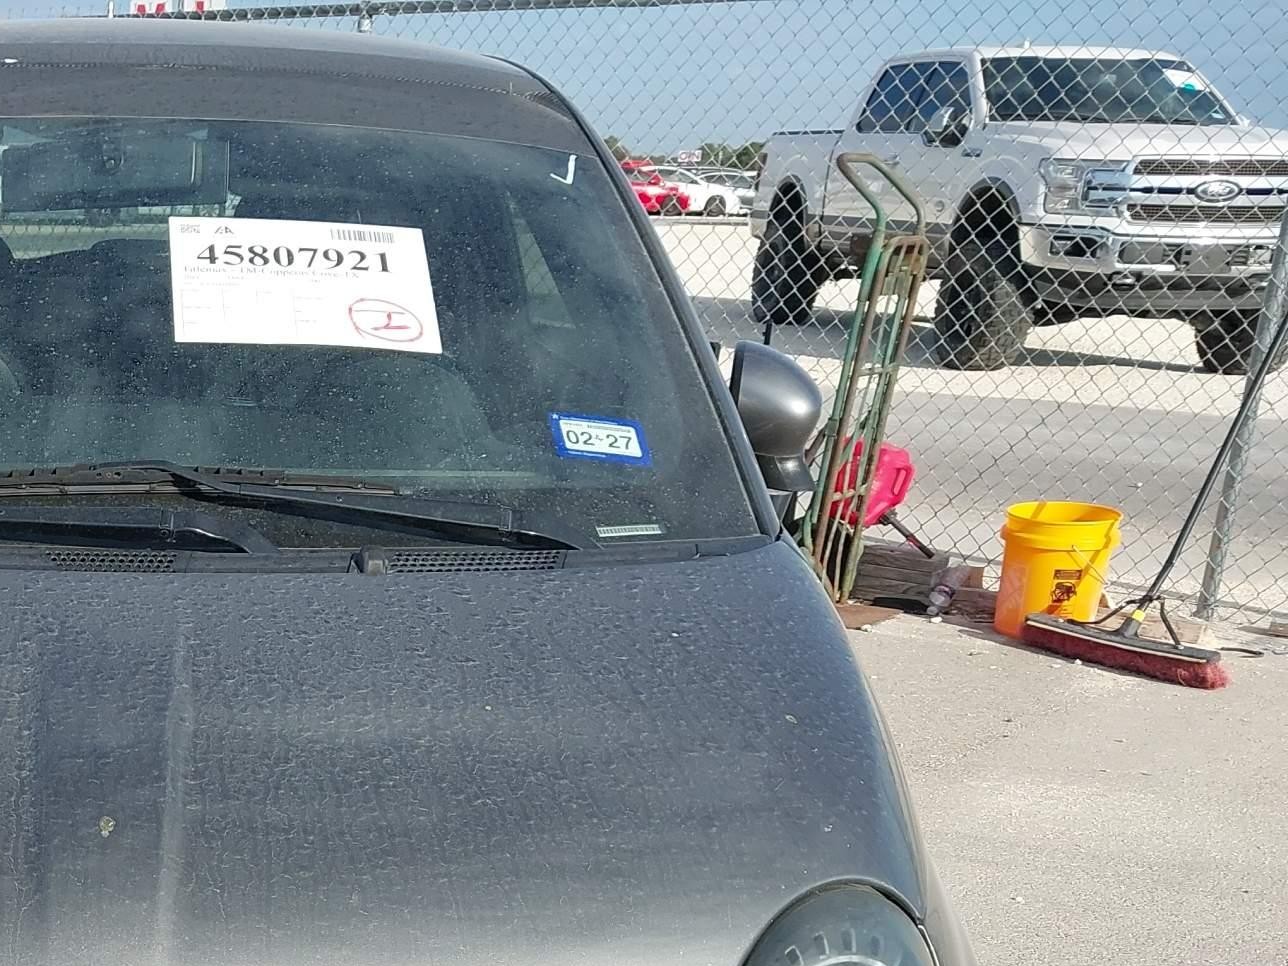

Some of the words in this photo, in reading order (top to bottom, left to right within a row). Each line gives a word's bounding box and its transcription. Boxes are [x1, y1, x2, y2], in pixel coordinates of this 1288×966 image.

[197, 243, 392, 274] 45807921
[566, 429, 595, 446] 02
[606, 433, 633, 450] 27
